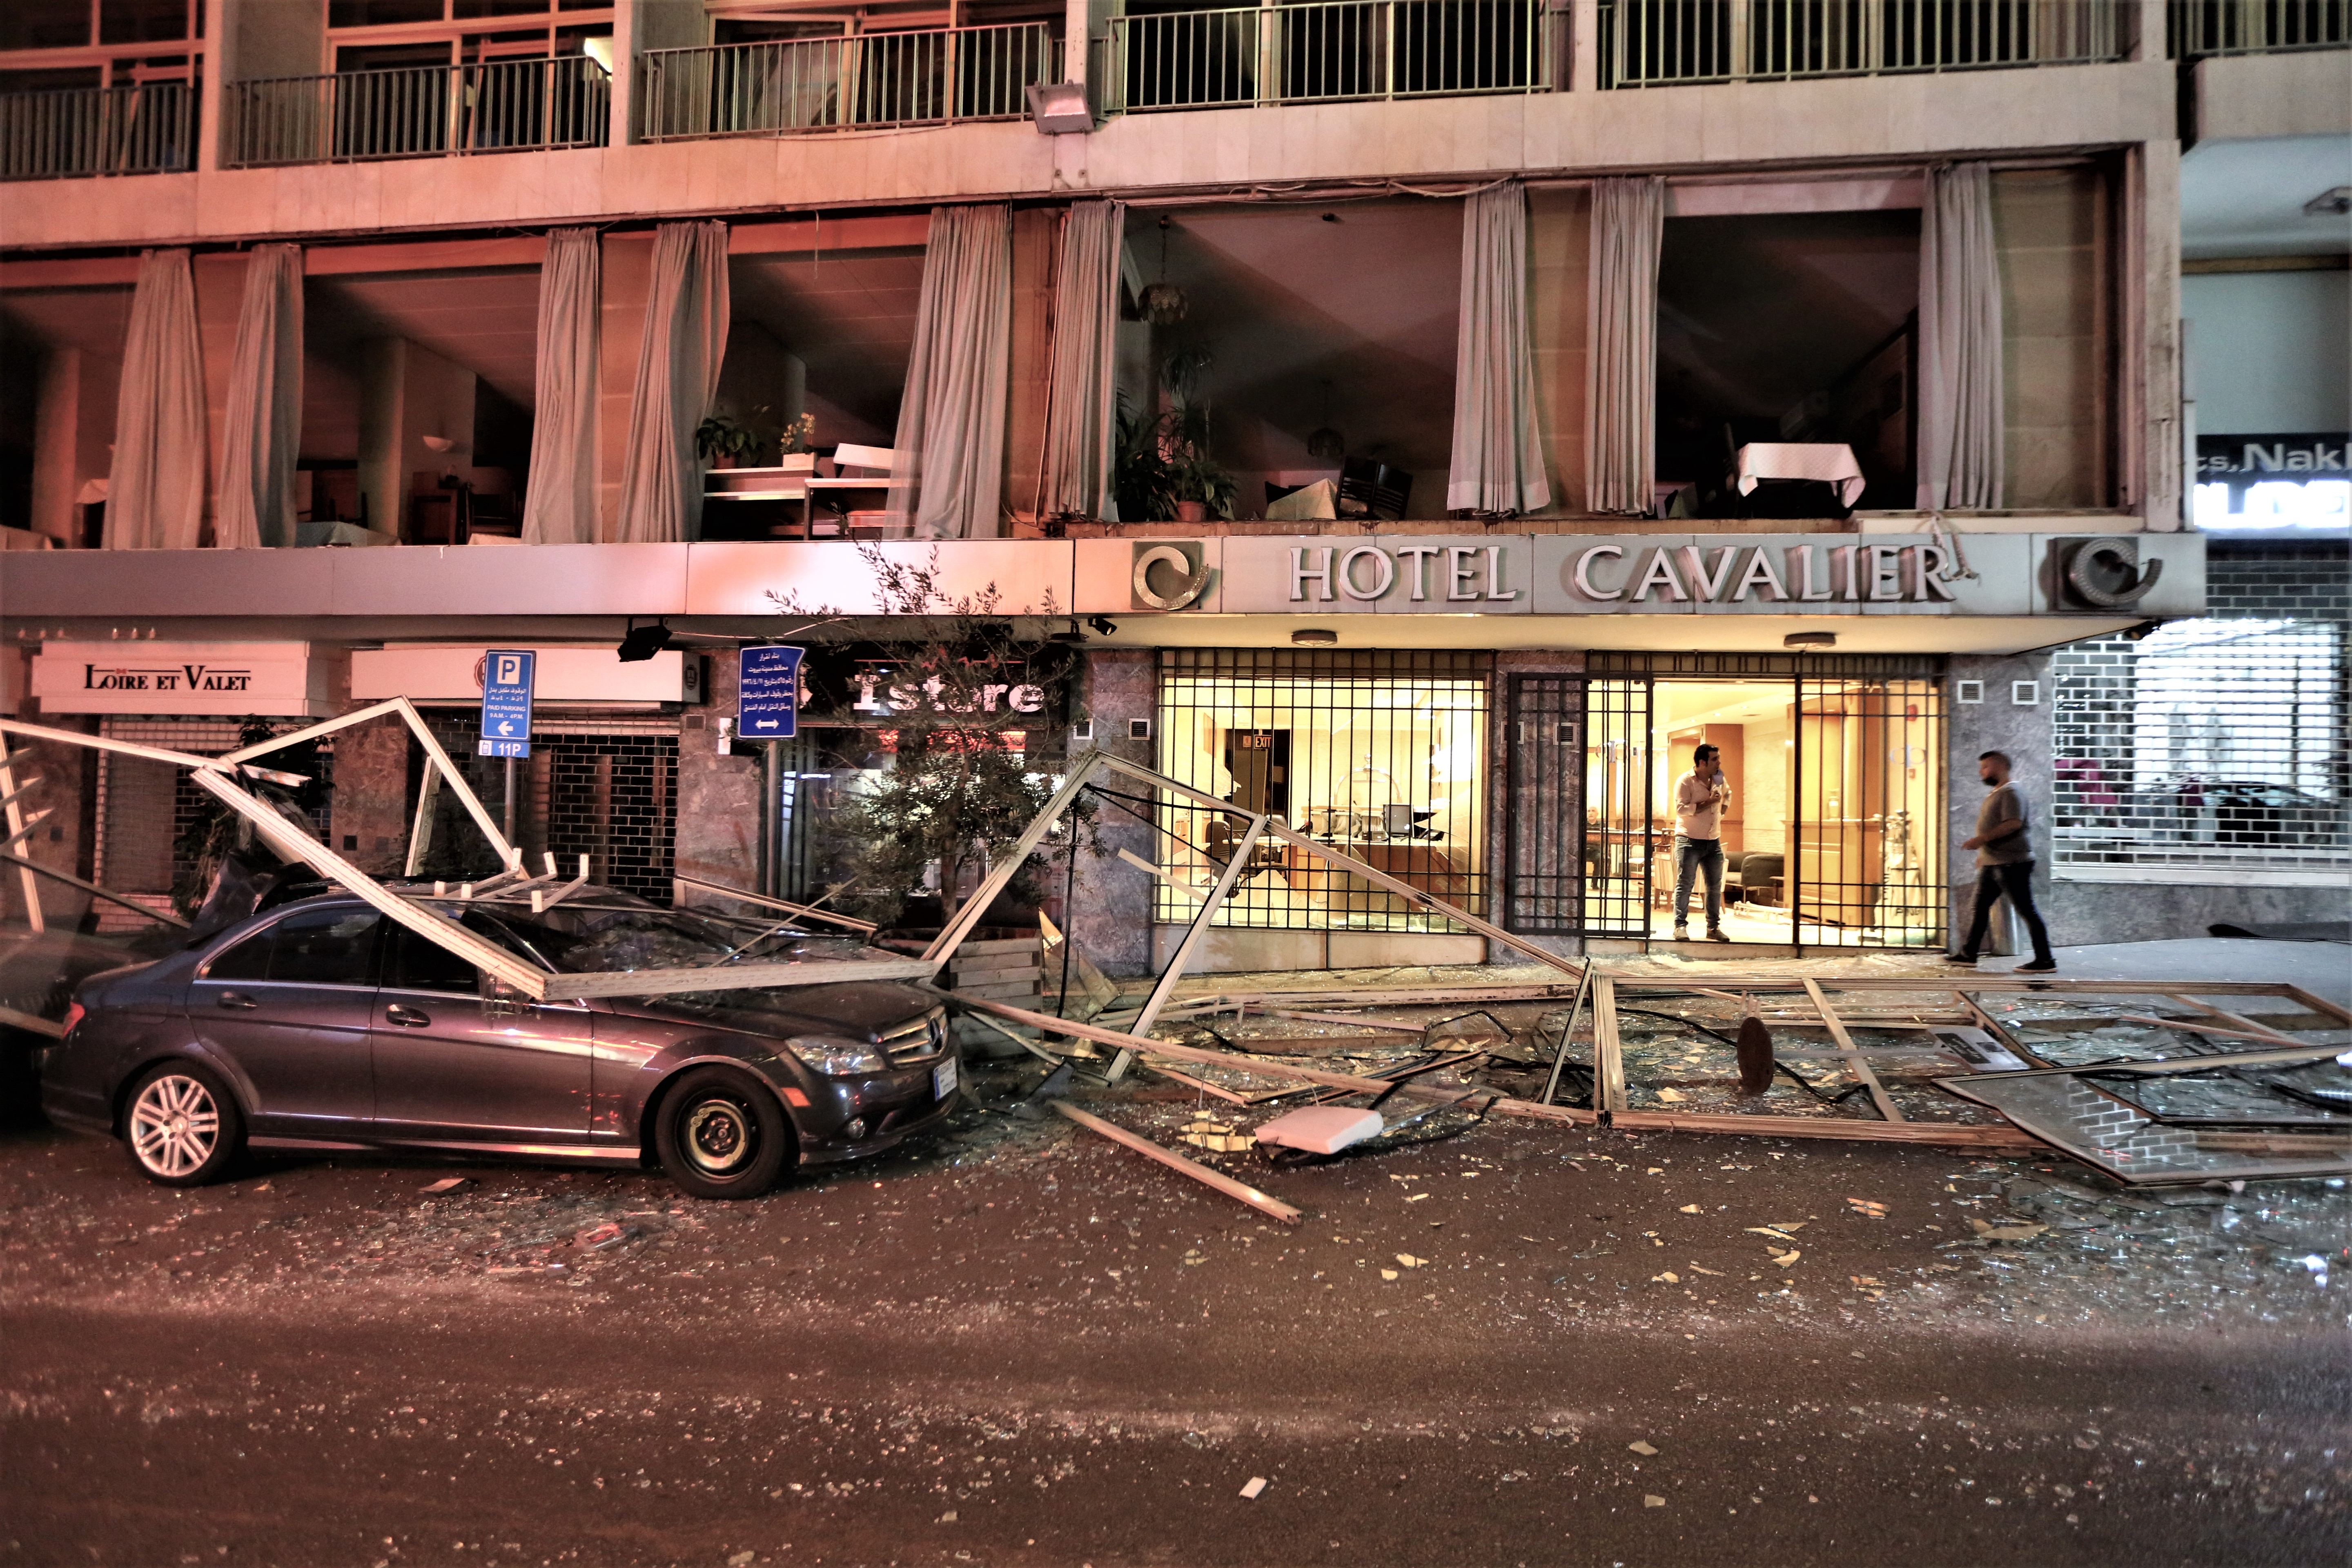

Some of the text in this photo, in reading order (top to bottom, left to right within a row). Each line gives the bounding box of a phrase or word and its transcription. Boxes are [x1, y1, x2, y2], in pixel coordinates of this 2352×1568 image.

[1290, 543, 1956, 603] HOTEL CAVALIER
[502, 659, 516, 680] P
[499, 743, 521, 756] 11P
[1255, 736, 1272, 748] EXIT
